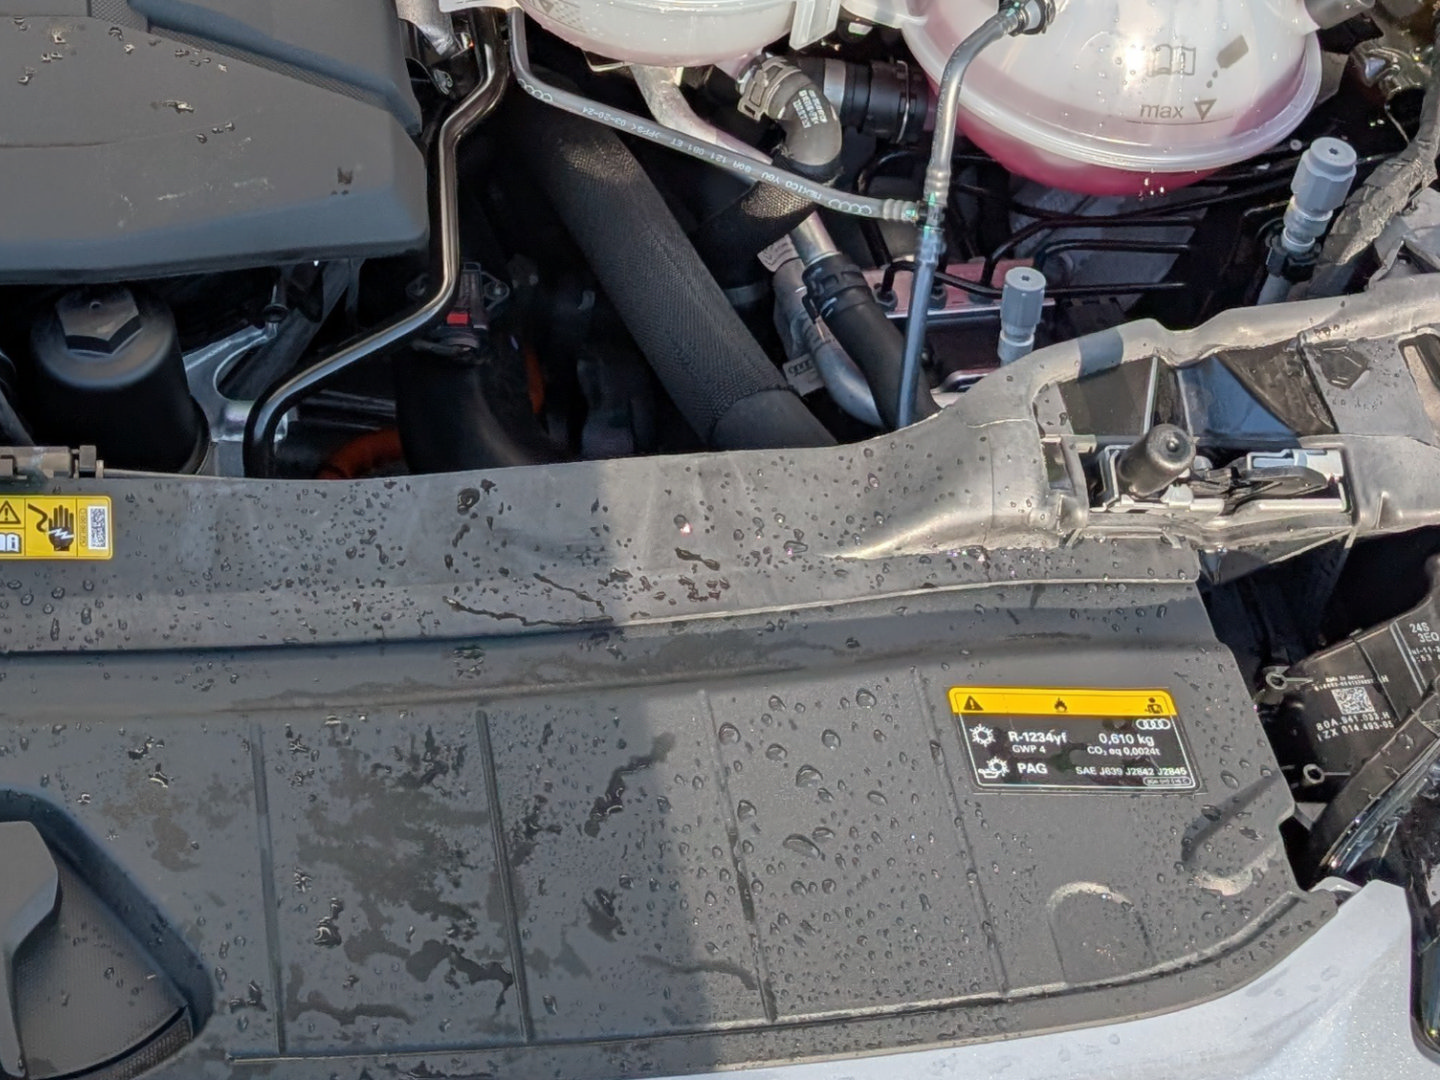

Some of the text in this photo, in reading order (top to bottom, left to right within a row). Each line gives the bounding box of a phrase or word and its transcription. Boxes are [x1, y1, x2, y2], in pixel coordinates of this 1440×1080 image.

[583, 107, 626, 127] 03-20-24
[1141, 102, 1183, 119] max
[786, 181, 822, 200] MEXICO
[1008, 731, 1067, 745] R-1234yf
[1137, 734, 1155, 747] kg
[1012, 745, 1046, 754] GWP 4
[1109, 748, 1122, 757] eq
[1017, 762, 1048, 774] PAG
[1075, 767, 1187, 776] SAE J639 J2842 J2845
